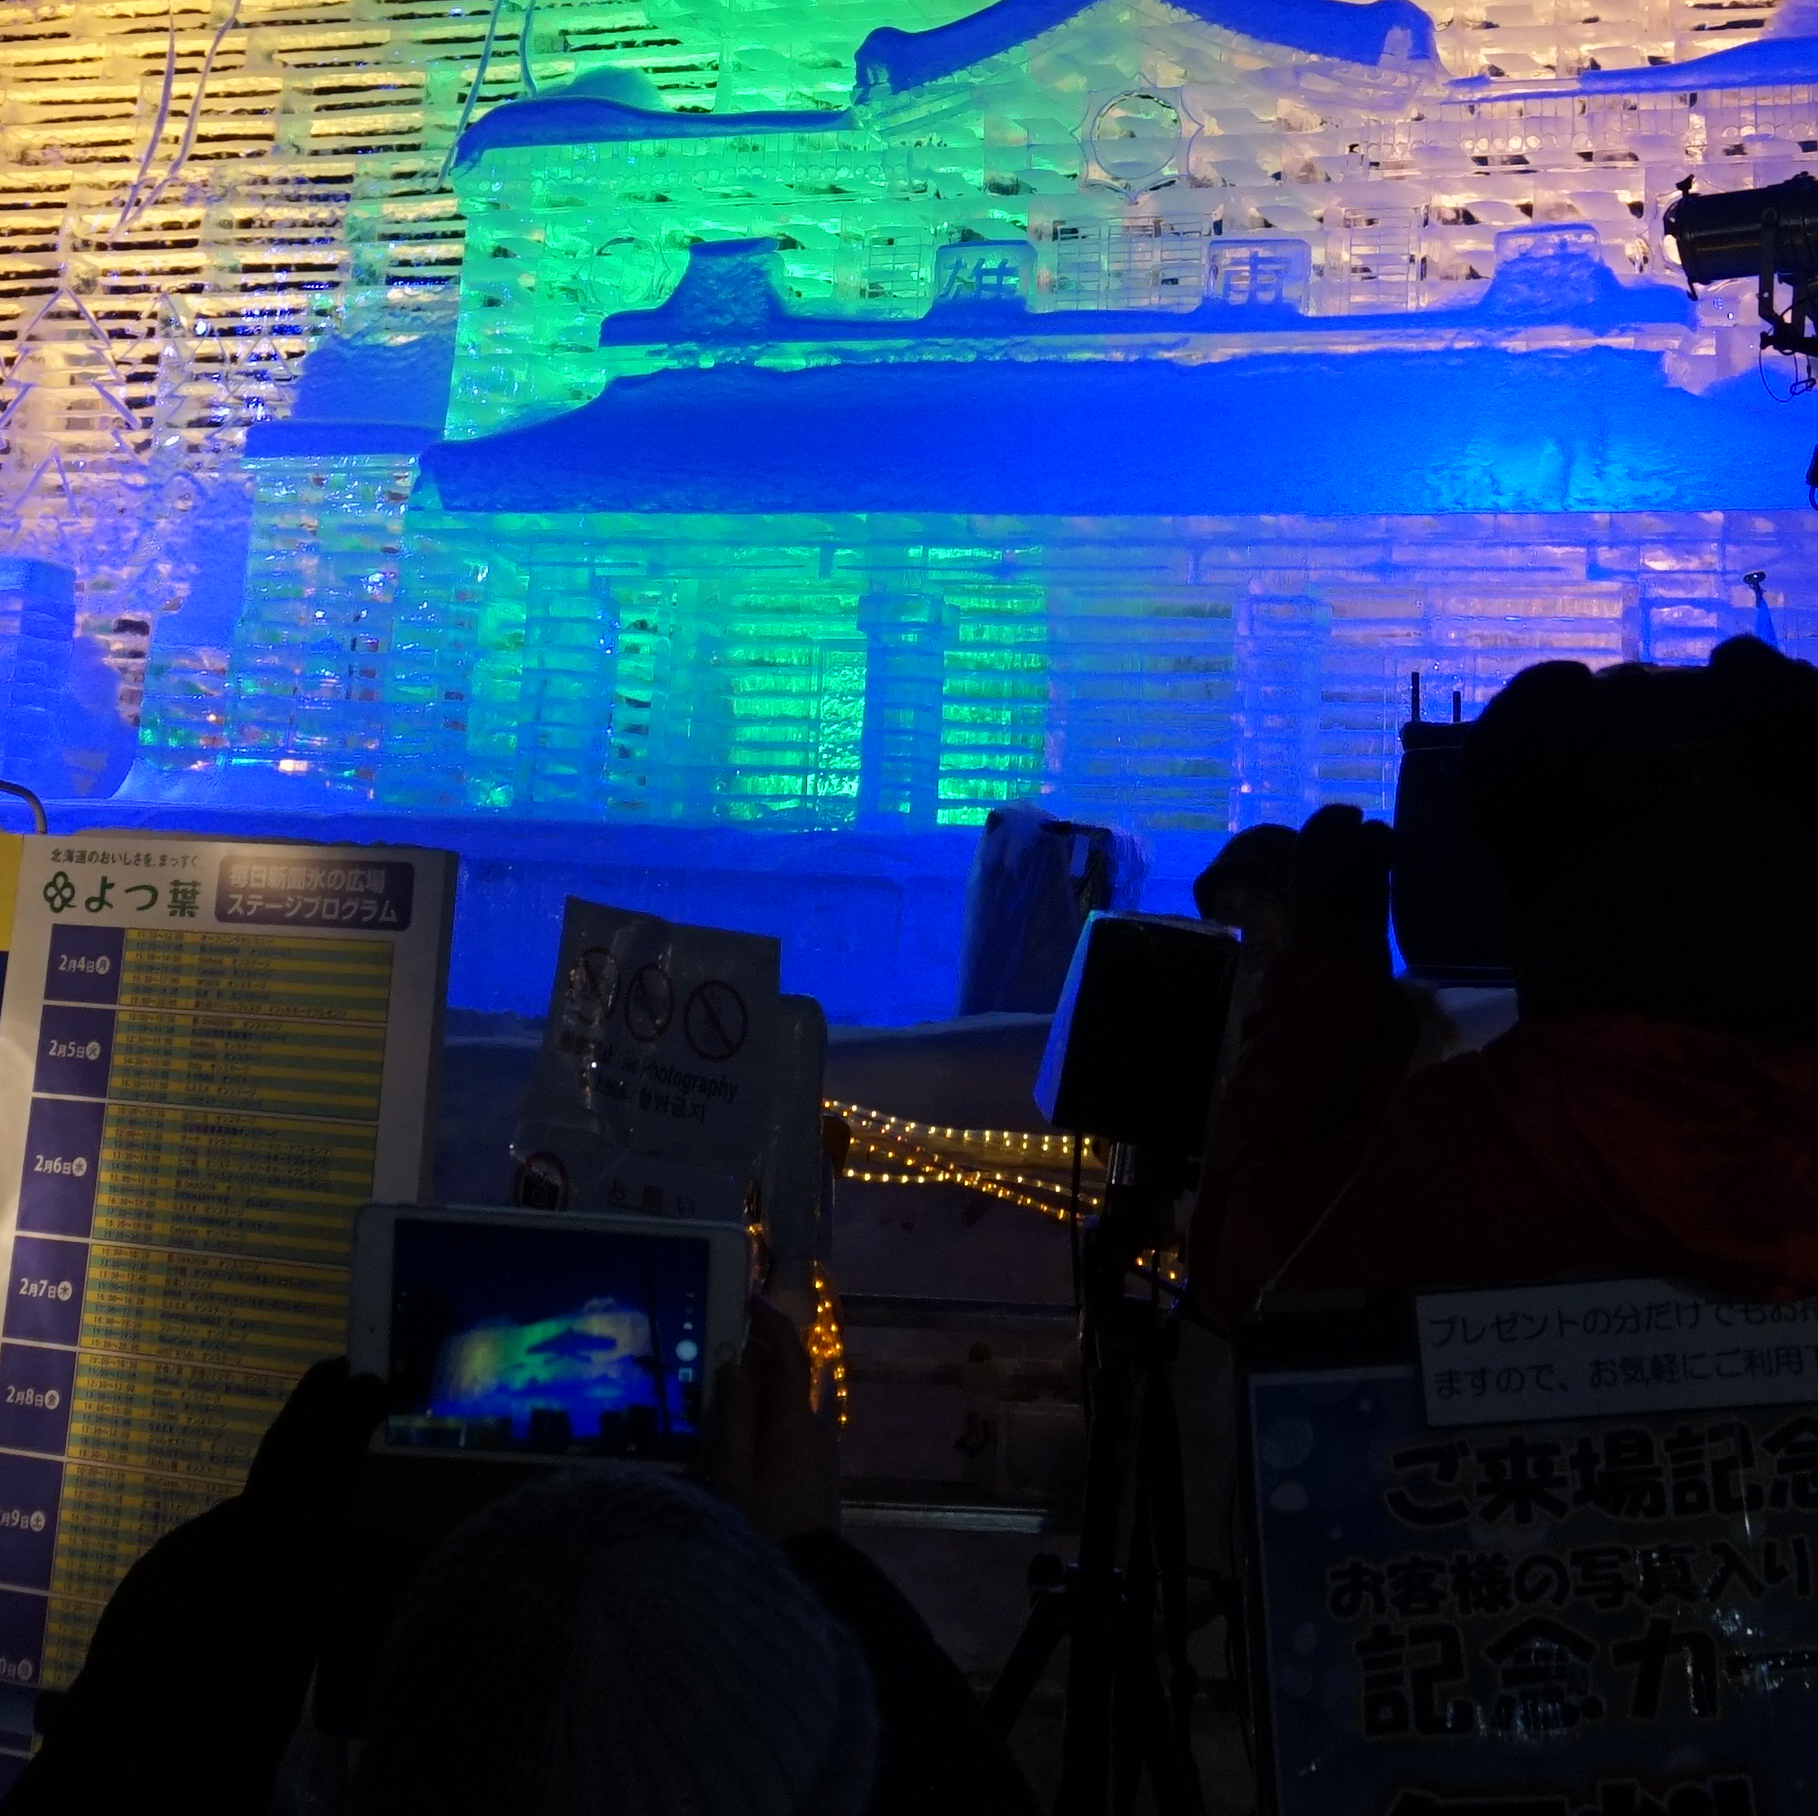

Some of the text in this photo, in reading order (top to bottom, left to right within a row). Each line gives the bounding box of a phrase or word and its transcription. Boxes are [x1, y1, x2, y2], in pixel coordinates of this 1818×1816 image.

[84, 874, 202, 919] よつ葉
[227, 892, 399, 924] ステージプログラム
[1328, 1538, 1811, 1617] お客様の写真入り
